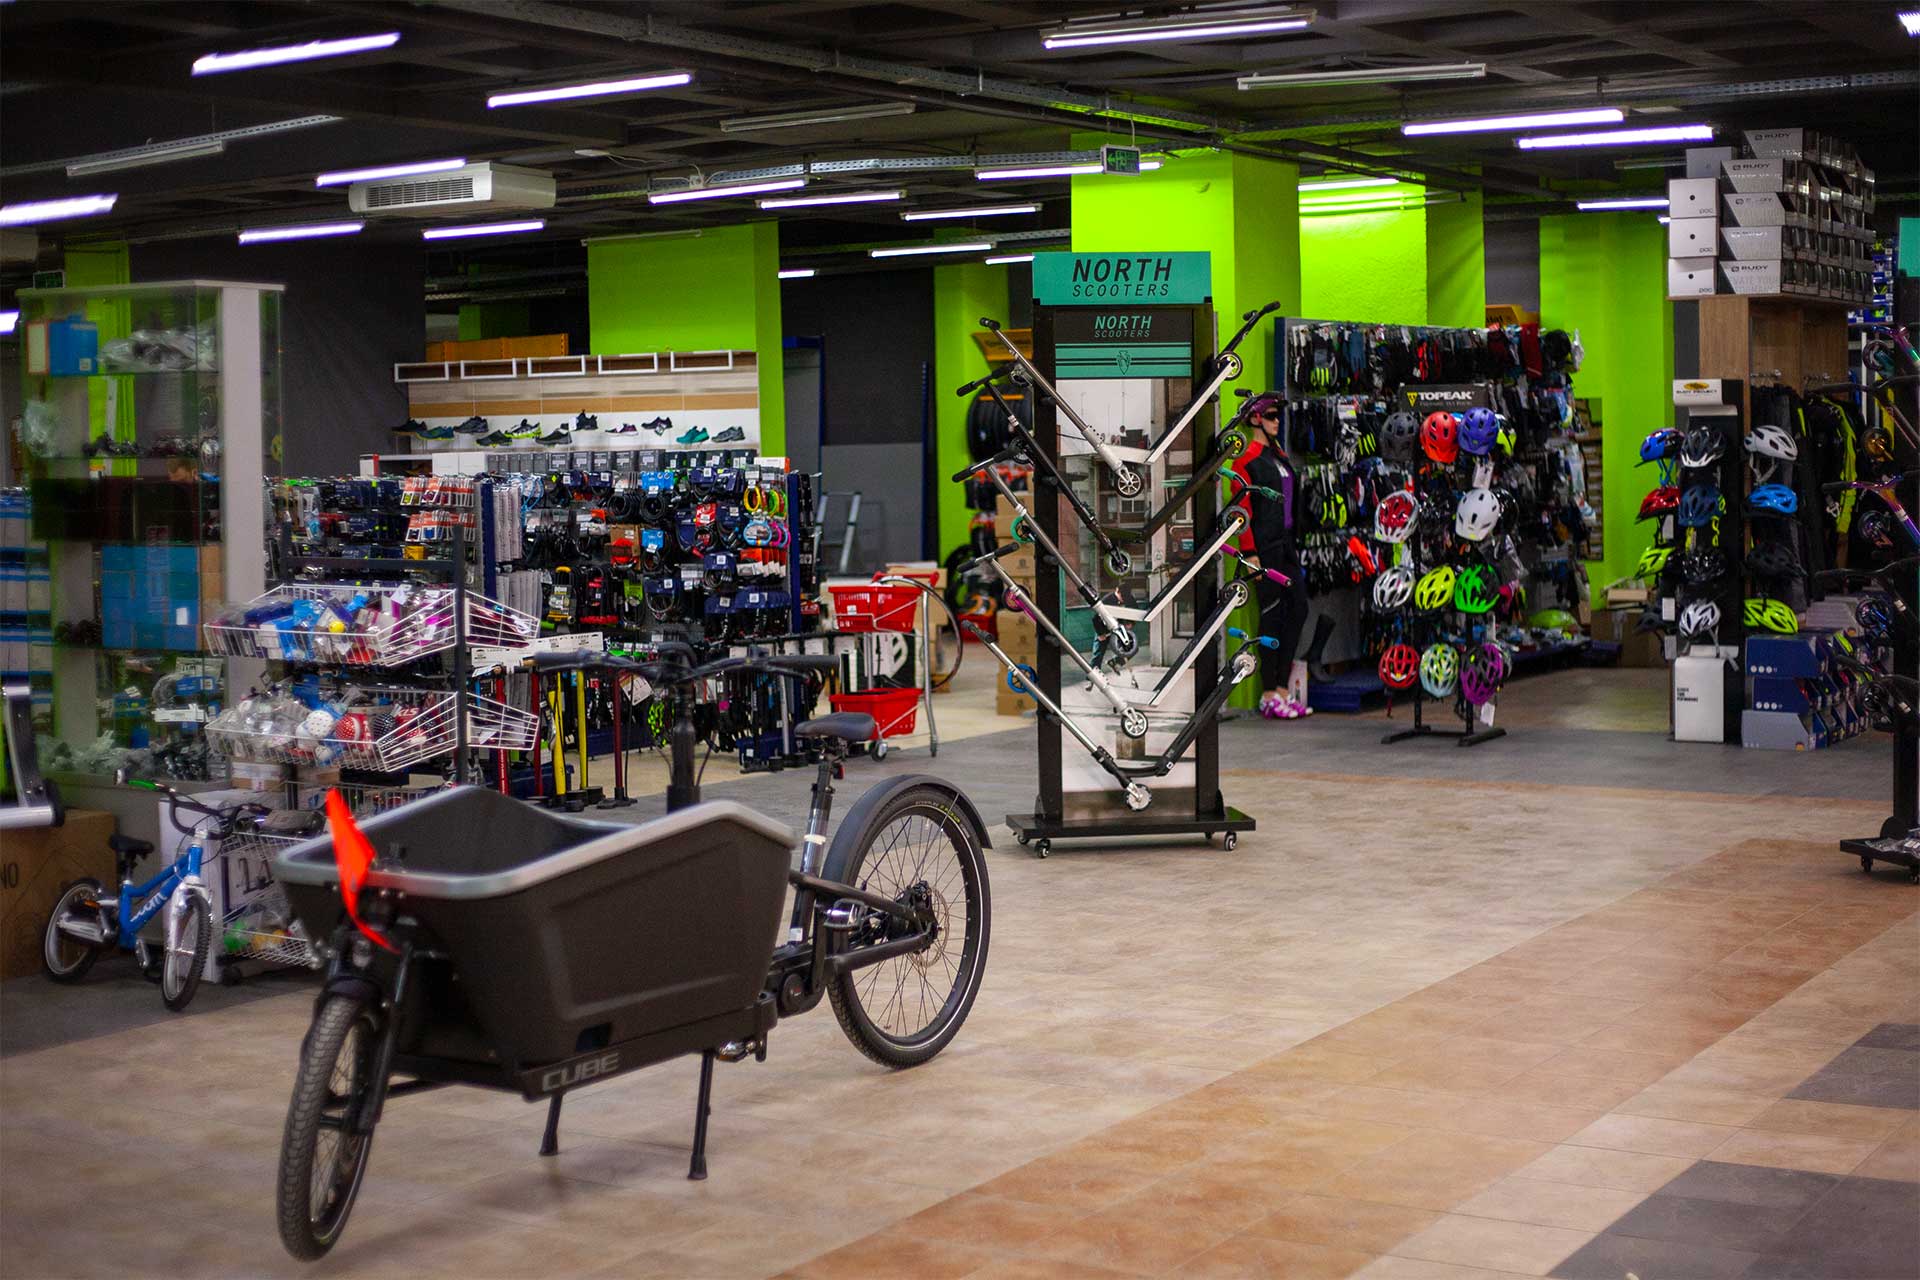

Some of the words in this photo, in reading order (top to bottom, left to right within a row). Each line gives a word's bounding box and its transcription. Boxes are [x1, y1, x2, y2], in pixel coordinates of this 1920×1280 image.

[1072, 258, 1173, 282] NORTH
[1072, 283, 1169, 297] SCOOTERS
[1094, 315, 1153, 329] NORTH
[1094, 329, 1150, 338] SCOOTERS
[1418, 391, 1473, 400] TOPEAK
[542, 1052, 620, 1092] CUBE
